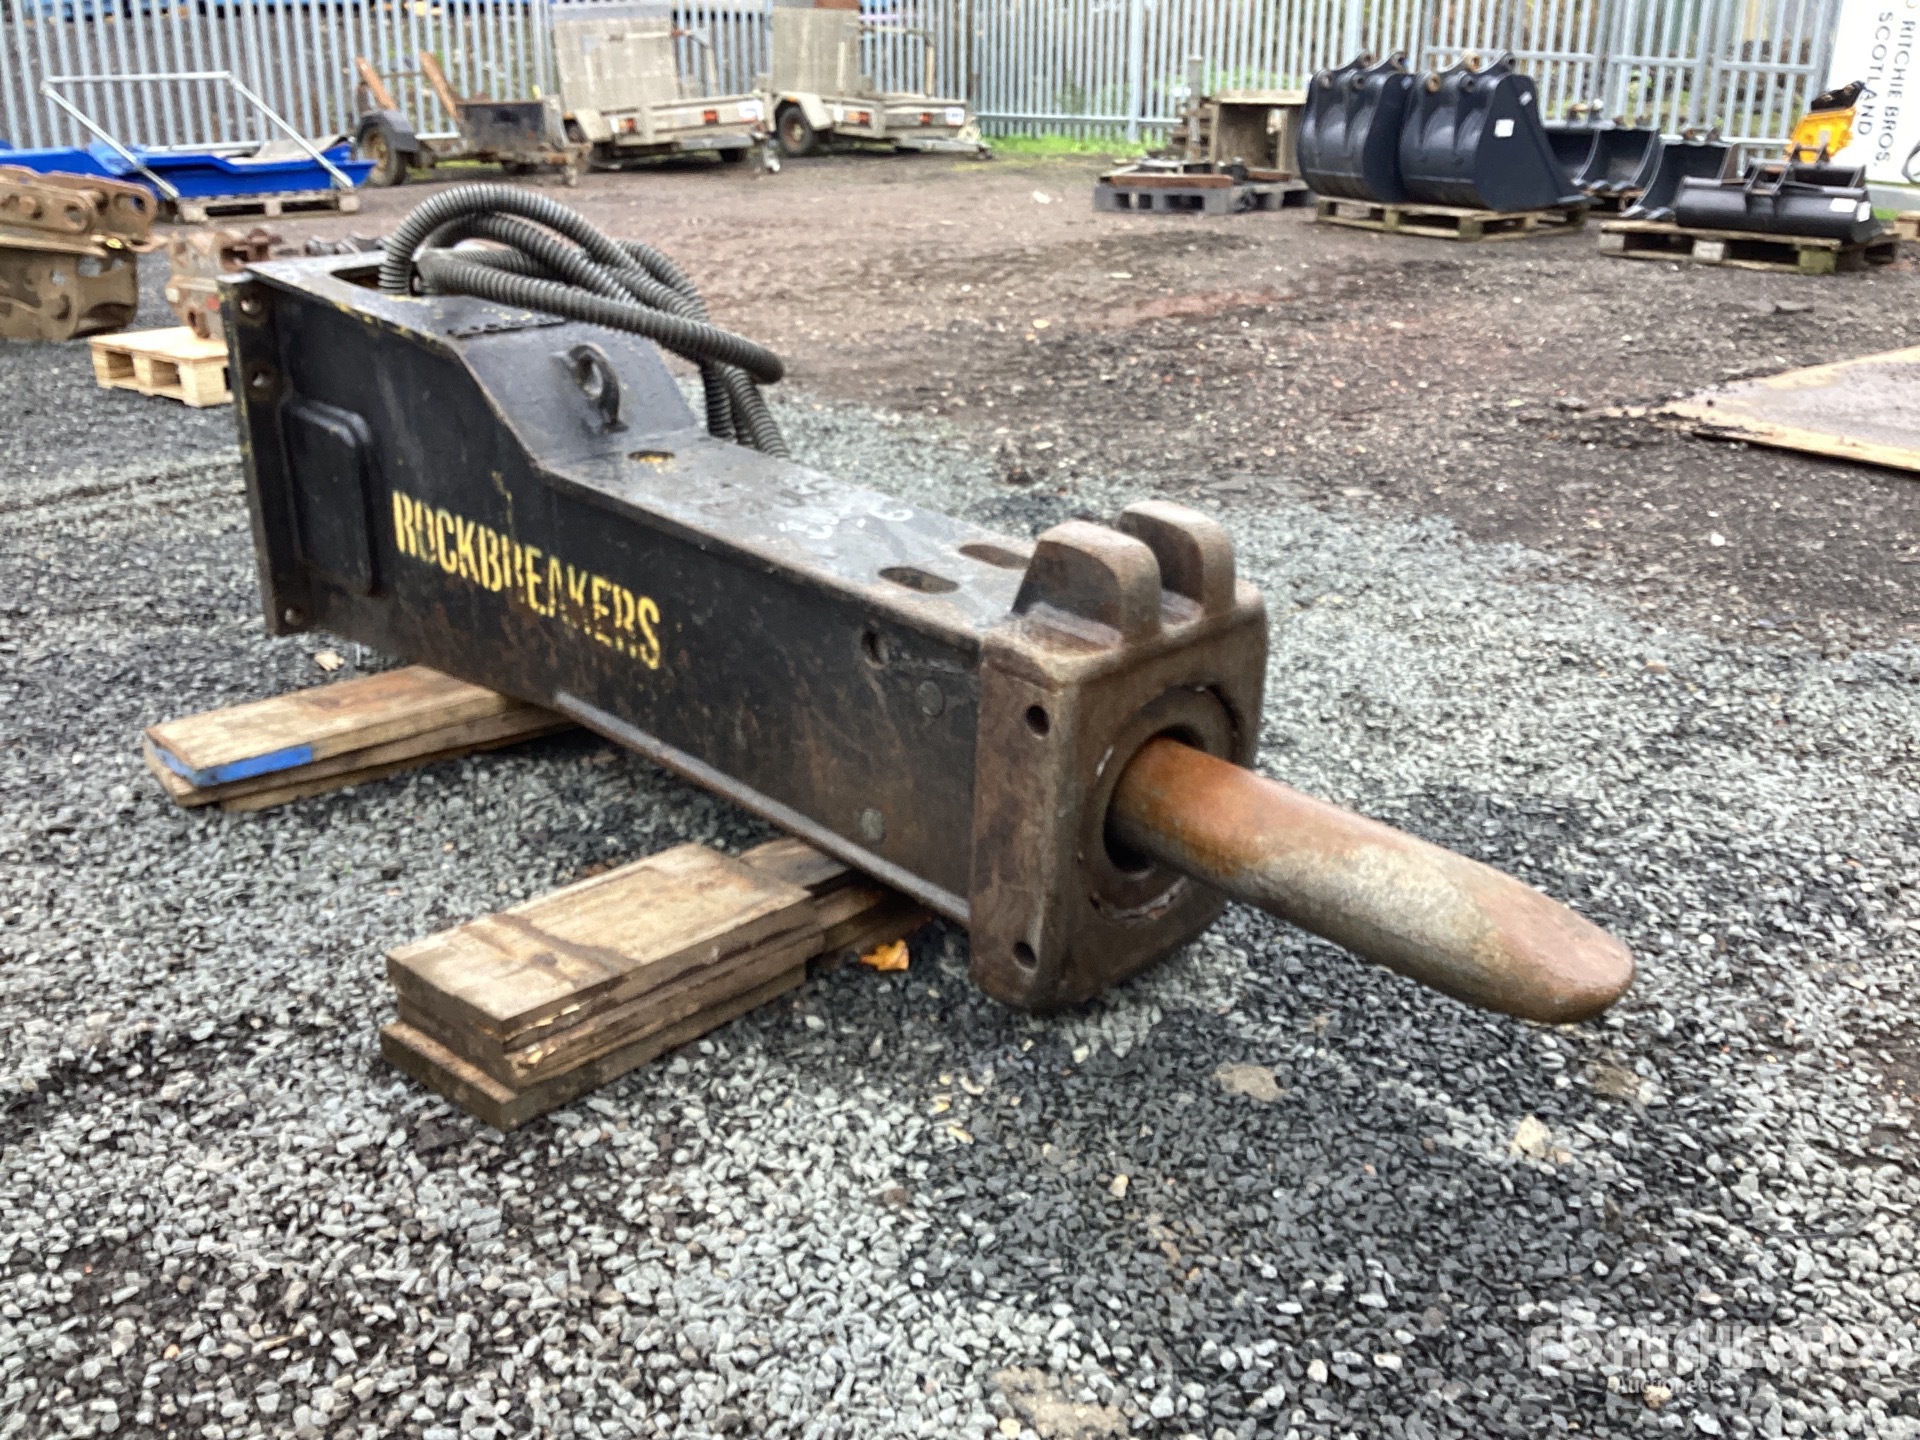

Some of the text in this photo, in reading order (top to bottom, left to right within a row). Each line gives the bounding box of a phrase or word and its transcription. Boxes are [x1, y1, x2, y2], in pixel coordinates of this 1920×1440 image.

[1857, 11, 1894, 136] SCOTLAND
[1886, 20, 1916, 98] RITCHIE
[392, 489, 660, 670] ROCKBREAKERS
